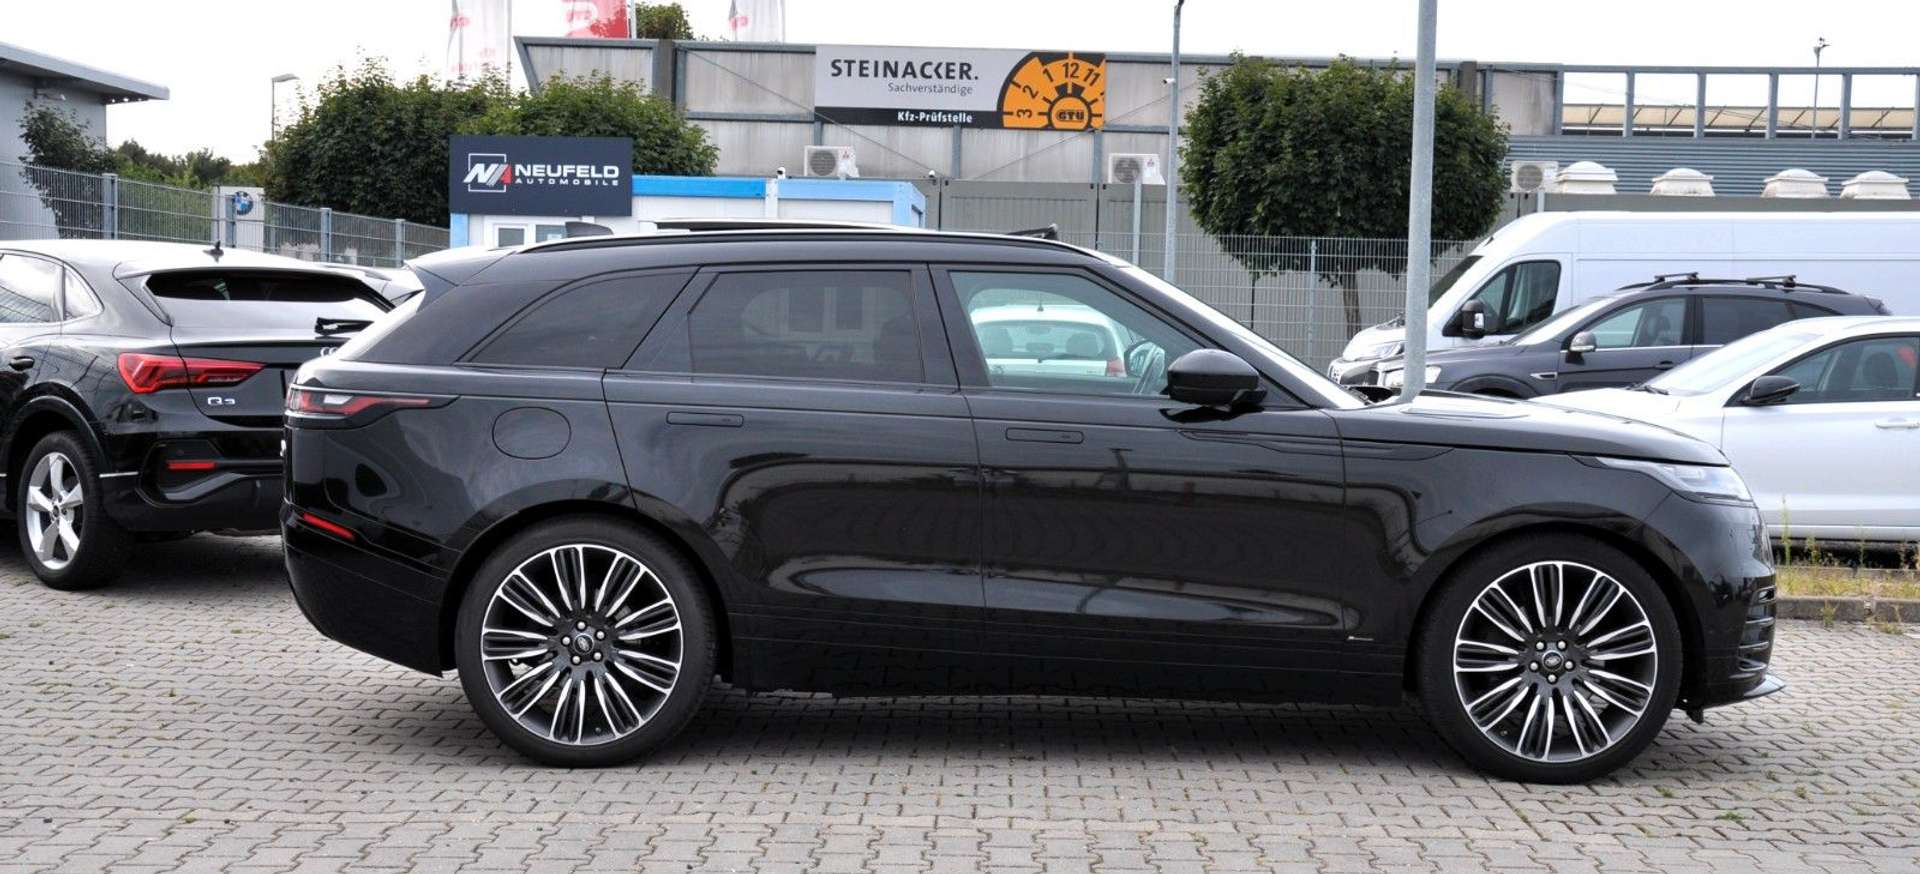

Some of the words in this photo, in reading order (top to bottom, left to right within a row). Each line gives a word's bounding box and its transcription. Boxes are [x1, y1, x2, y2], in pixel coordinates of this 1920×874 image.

[831, 58, 979, 81] STEINACKER.
[1042, 68, 1054, 82] 1
[1062, 62, 1080, 79] 12
[1083, 68, 1101, 87] 11
[888, 82, 974, 96] Sachverständige
[1022, 84, 1039, 99] 2
[897, 110, 973, 124] Kfz-Prüfstelle
[1016, 109, 1032, 118] 3
[514, 164, 619, 179] NEUFELD
[514, 178, 619, 186] AUTOMOBILE
[207, 396, 236, 406] Q3
